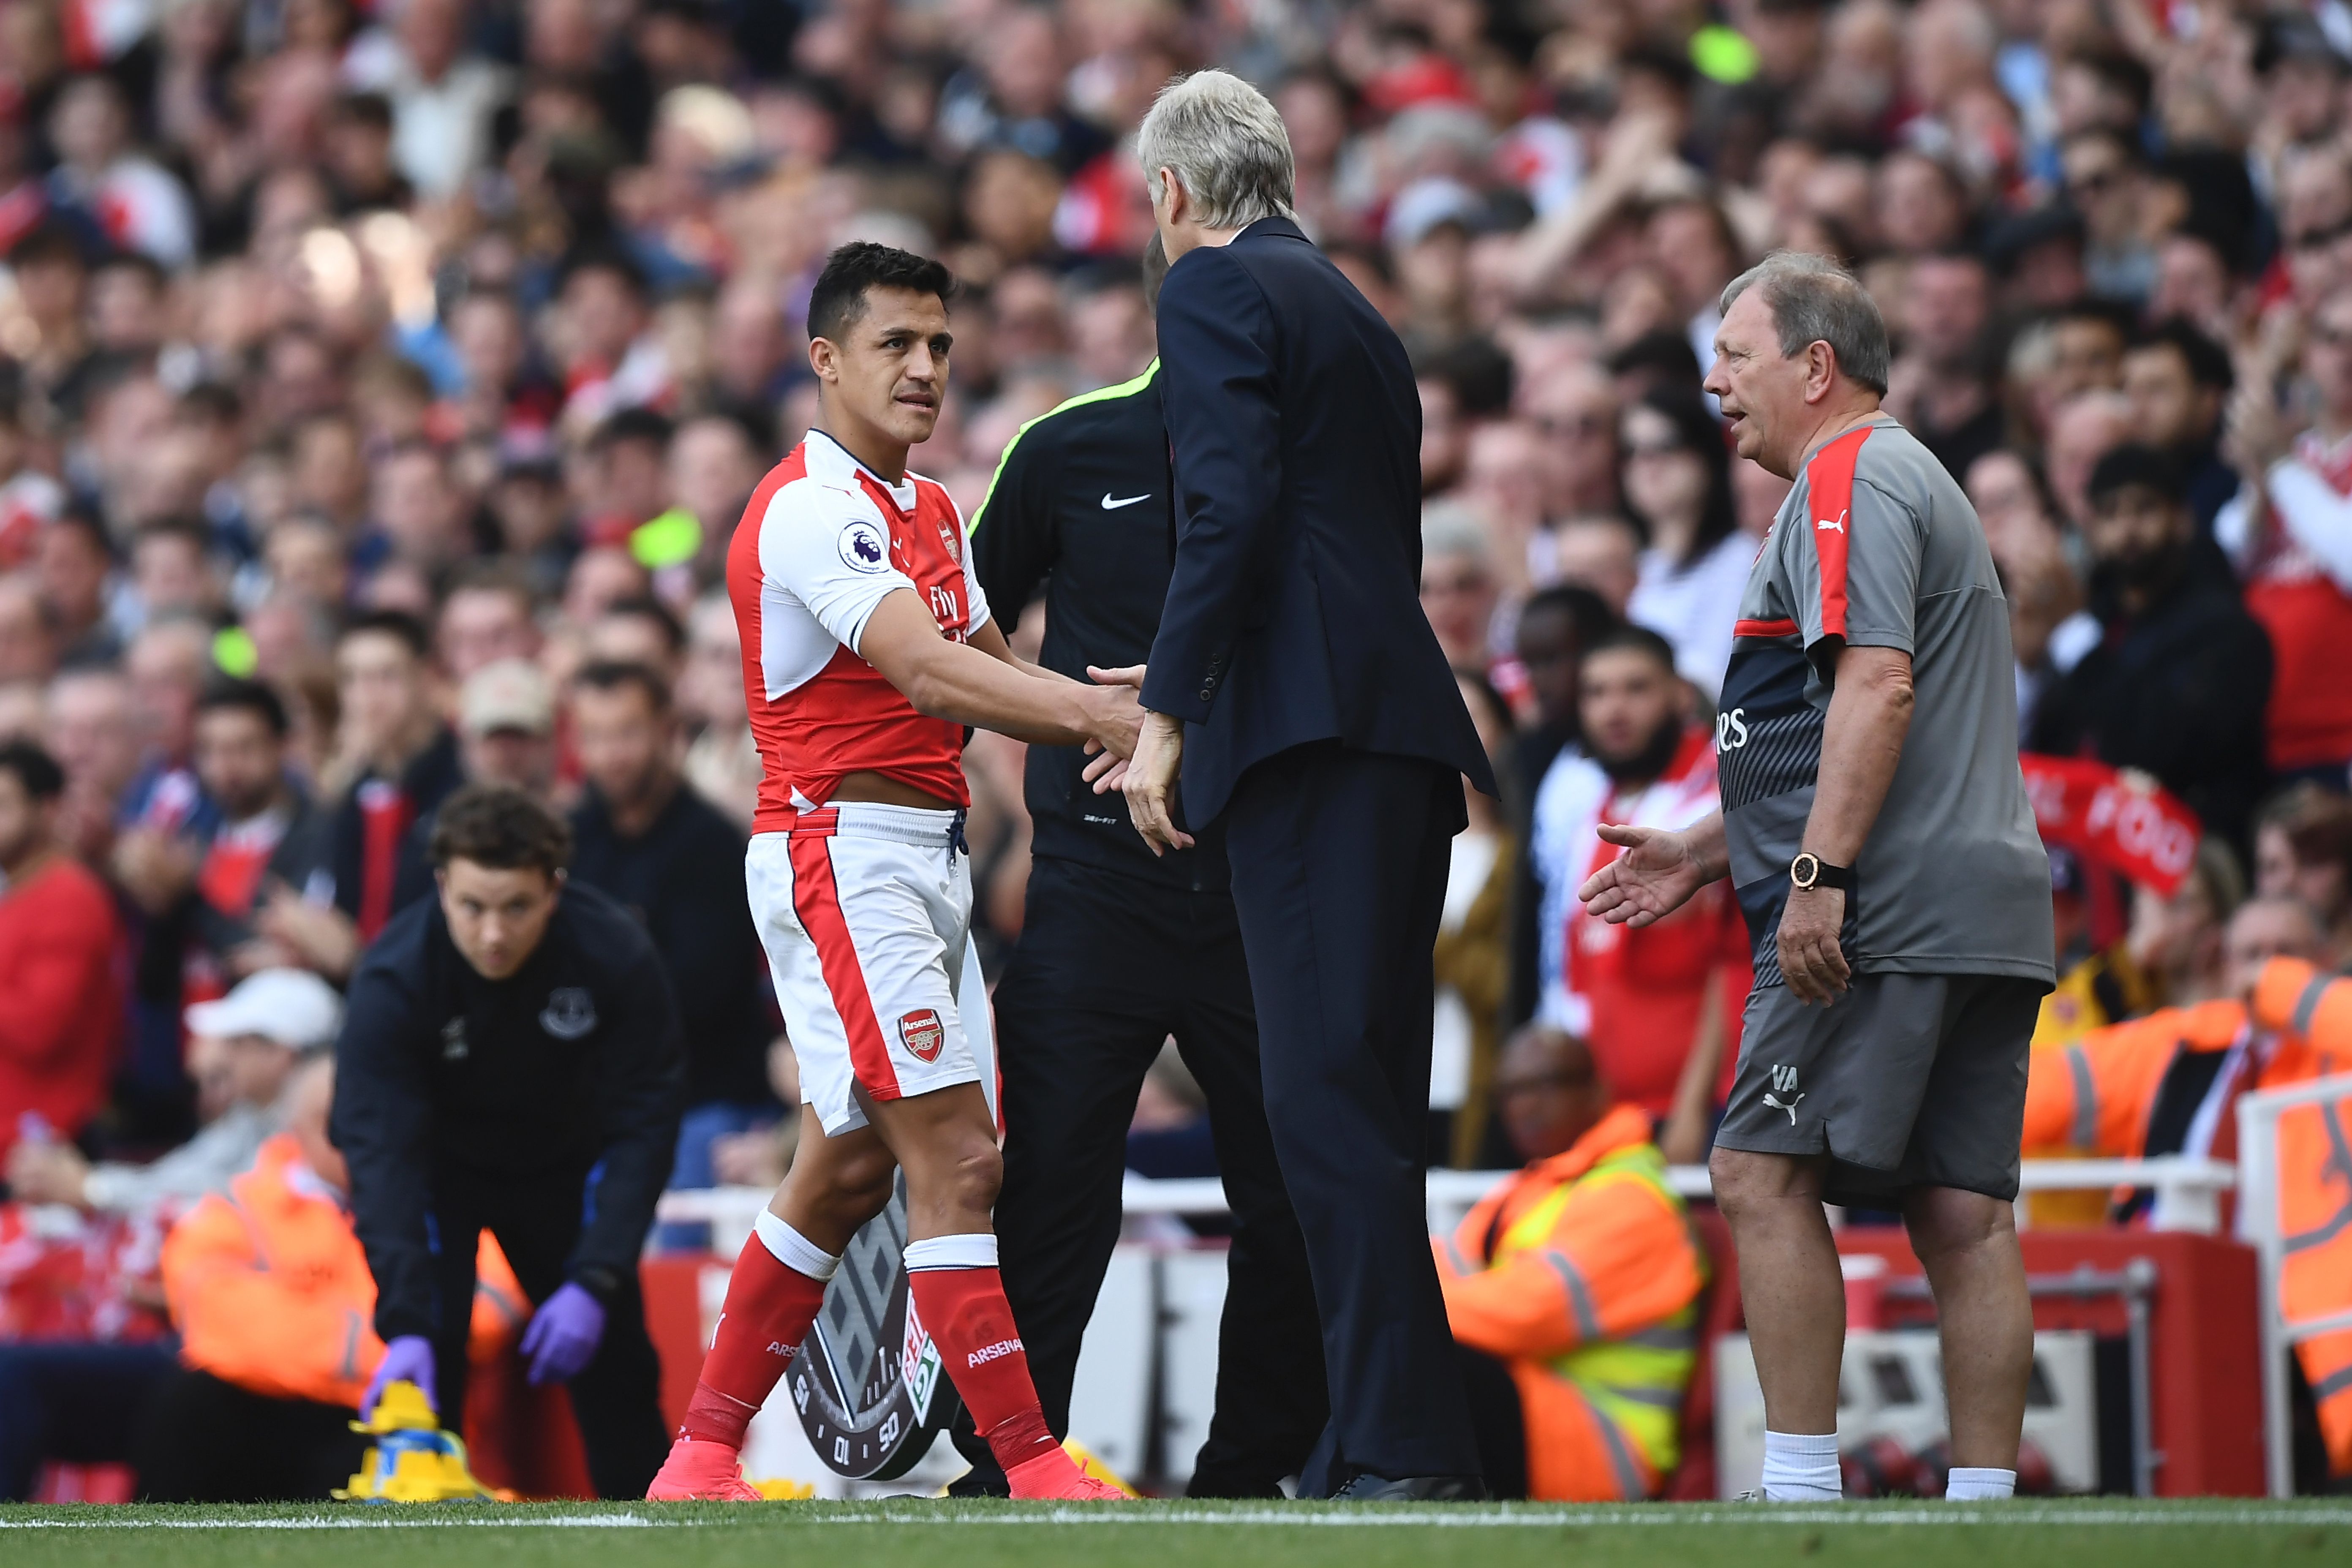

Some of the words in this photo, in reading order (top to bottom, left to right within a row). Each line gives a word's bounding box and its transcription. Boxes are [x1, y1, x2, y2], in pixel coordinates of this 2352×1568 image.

[929, 585, 959, 621] Fly
[904, 1015, 937, 1031] Arsenal
[1772, 1064, 1798, 1092] VA
[833, 1435, 850, 1466] 10
